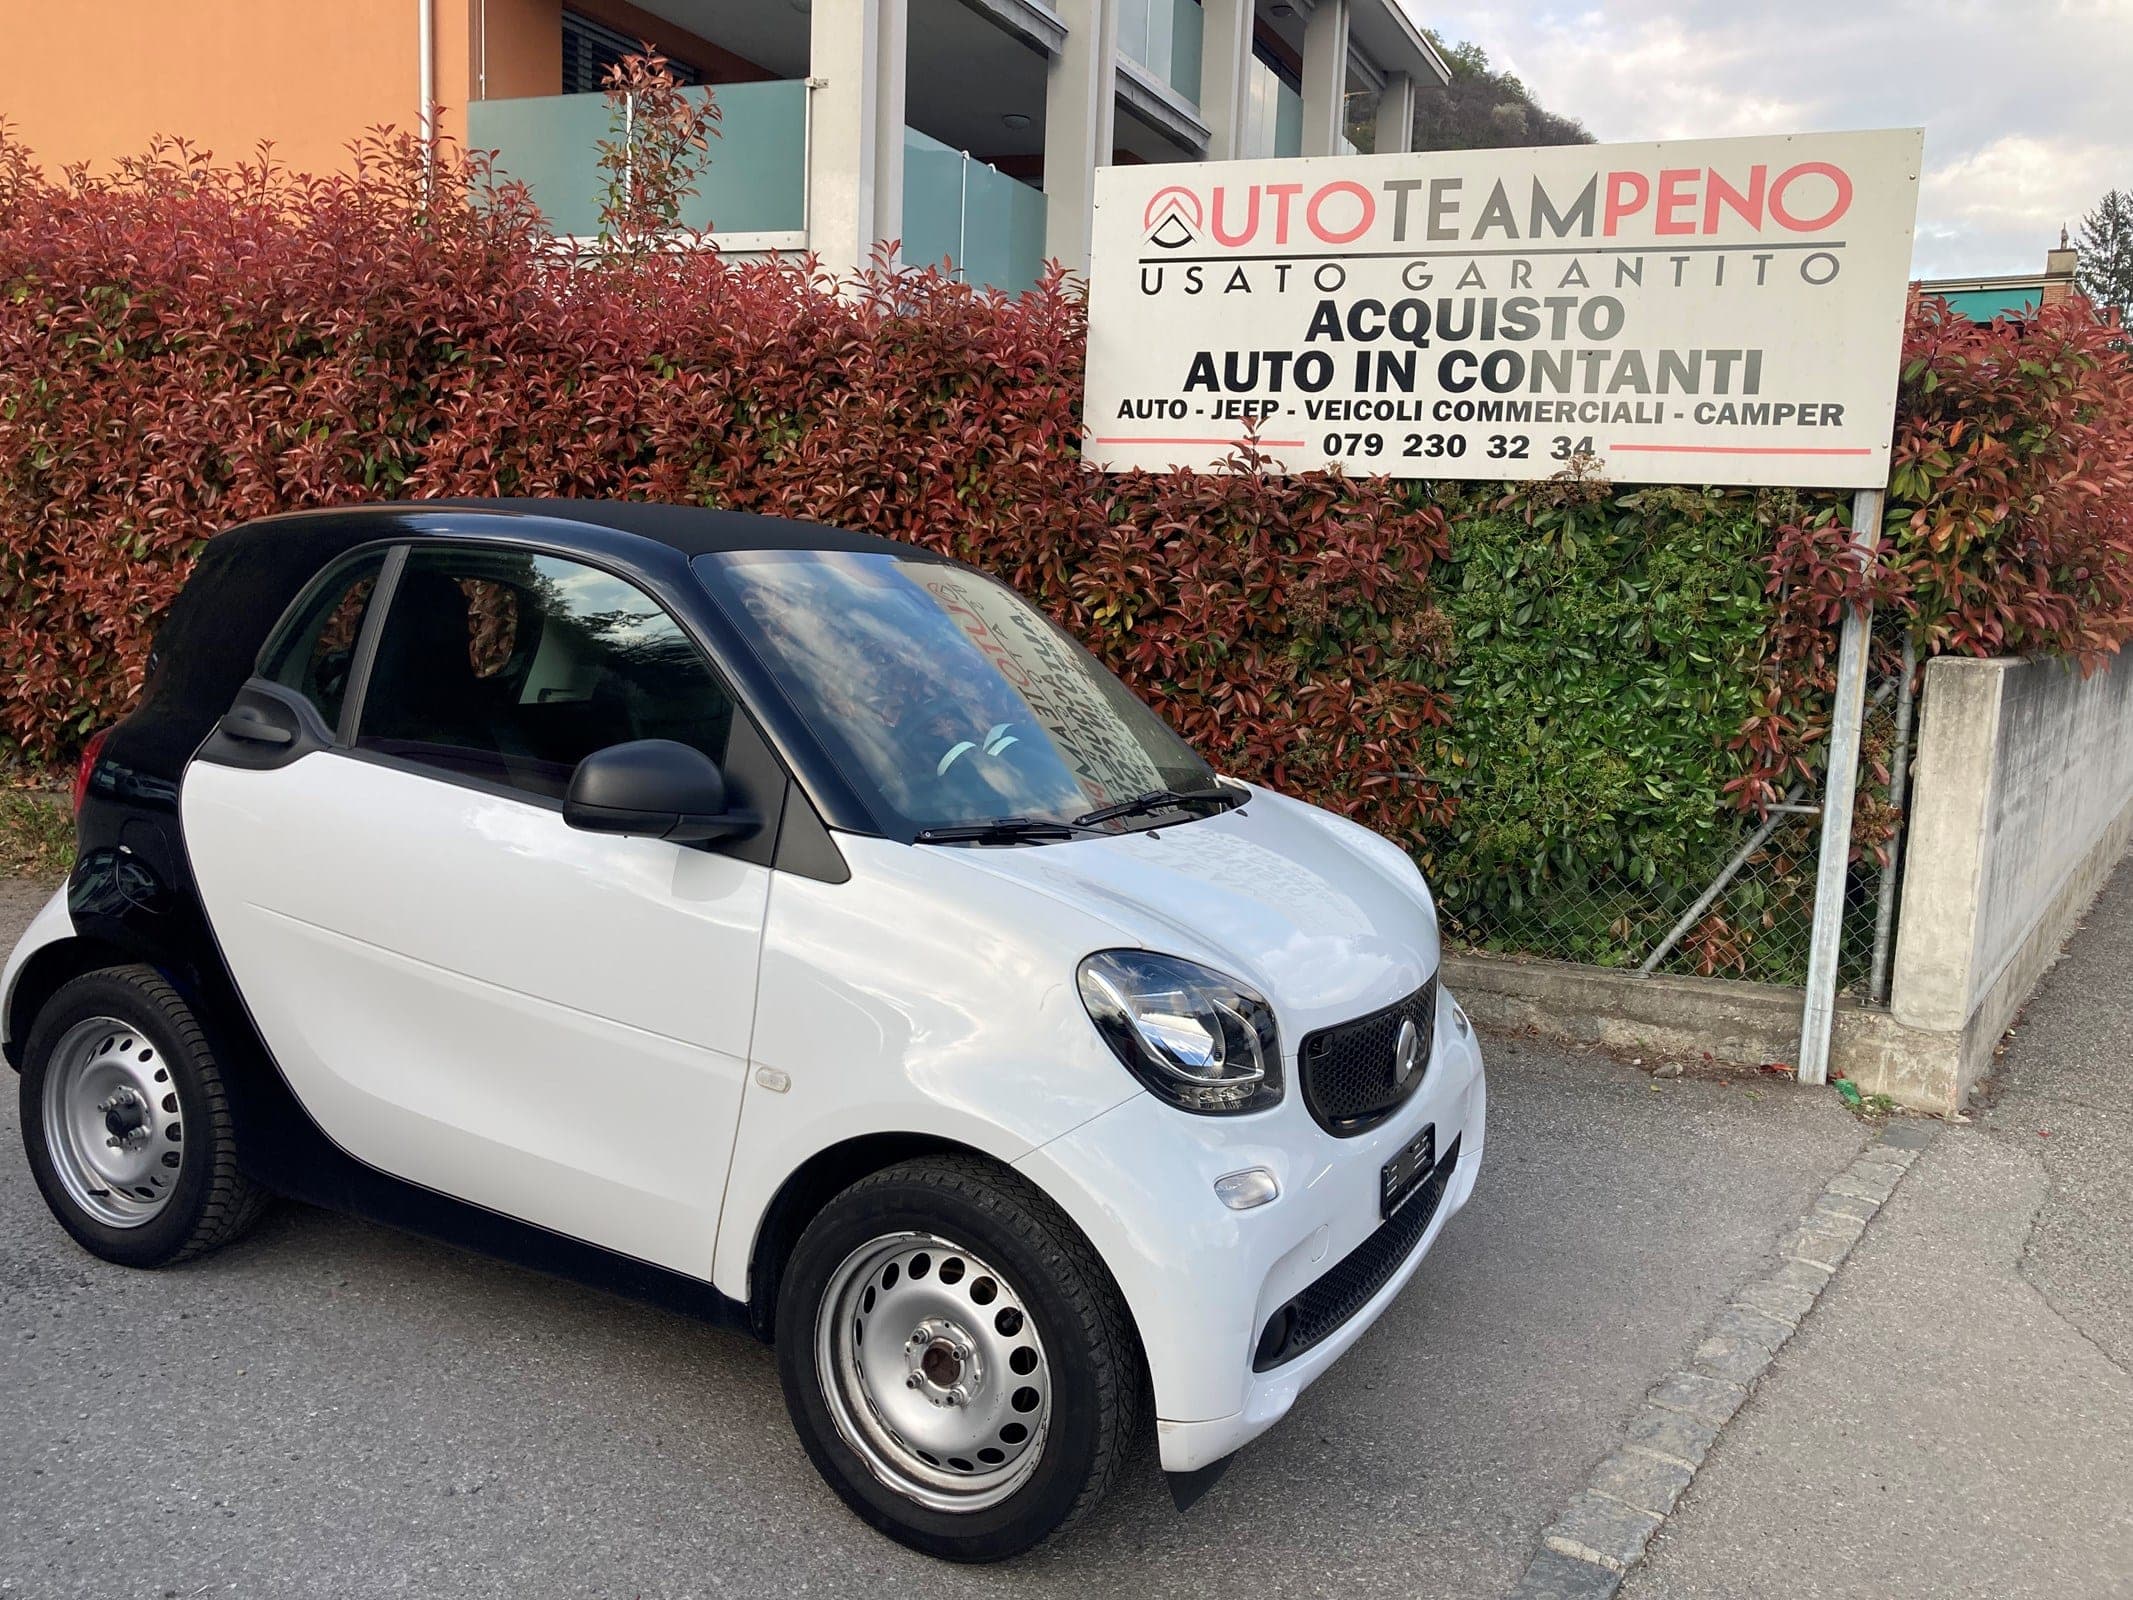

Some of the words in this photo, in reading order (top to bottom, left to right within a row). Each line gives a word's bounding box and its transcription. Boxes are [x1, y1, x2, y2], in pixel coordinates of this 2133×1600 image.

[1141, 261, 1346, 295] USATO
[1402, 252, 1840, 291] GARANTITO
[1304, 295, 1625, 348] ACQUISTO
[1183, 350, 1334, 393] AUTO
[1355, 350, 1416, 393] IN
[1438, 349, 1763, 395] CONTANTI
[1117, 399, 1186, 419] AUTO
[1211, 399, 1279, 420] JEEP
[1305, 399, 1422, 421] VEICOLI
[1432, 399, 1664, 424] COMMERCIALI
[1694, 402, 1844, 426] CAMPER
[1322, 433, 1383, 456] 079
[1402, 433, 1466, 457] 230
[1486, 434, 1530, 459] 32
[1550, 436, 1595, 460] 34
